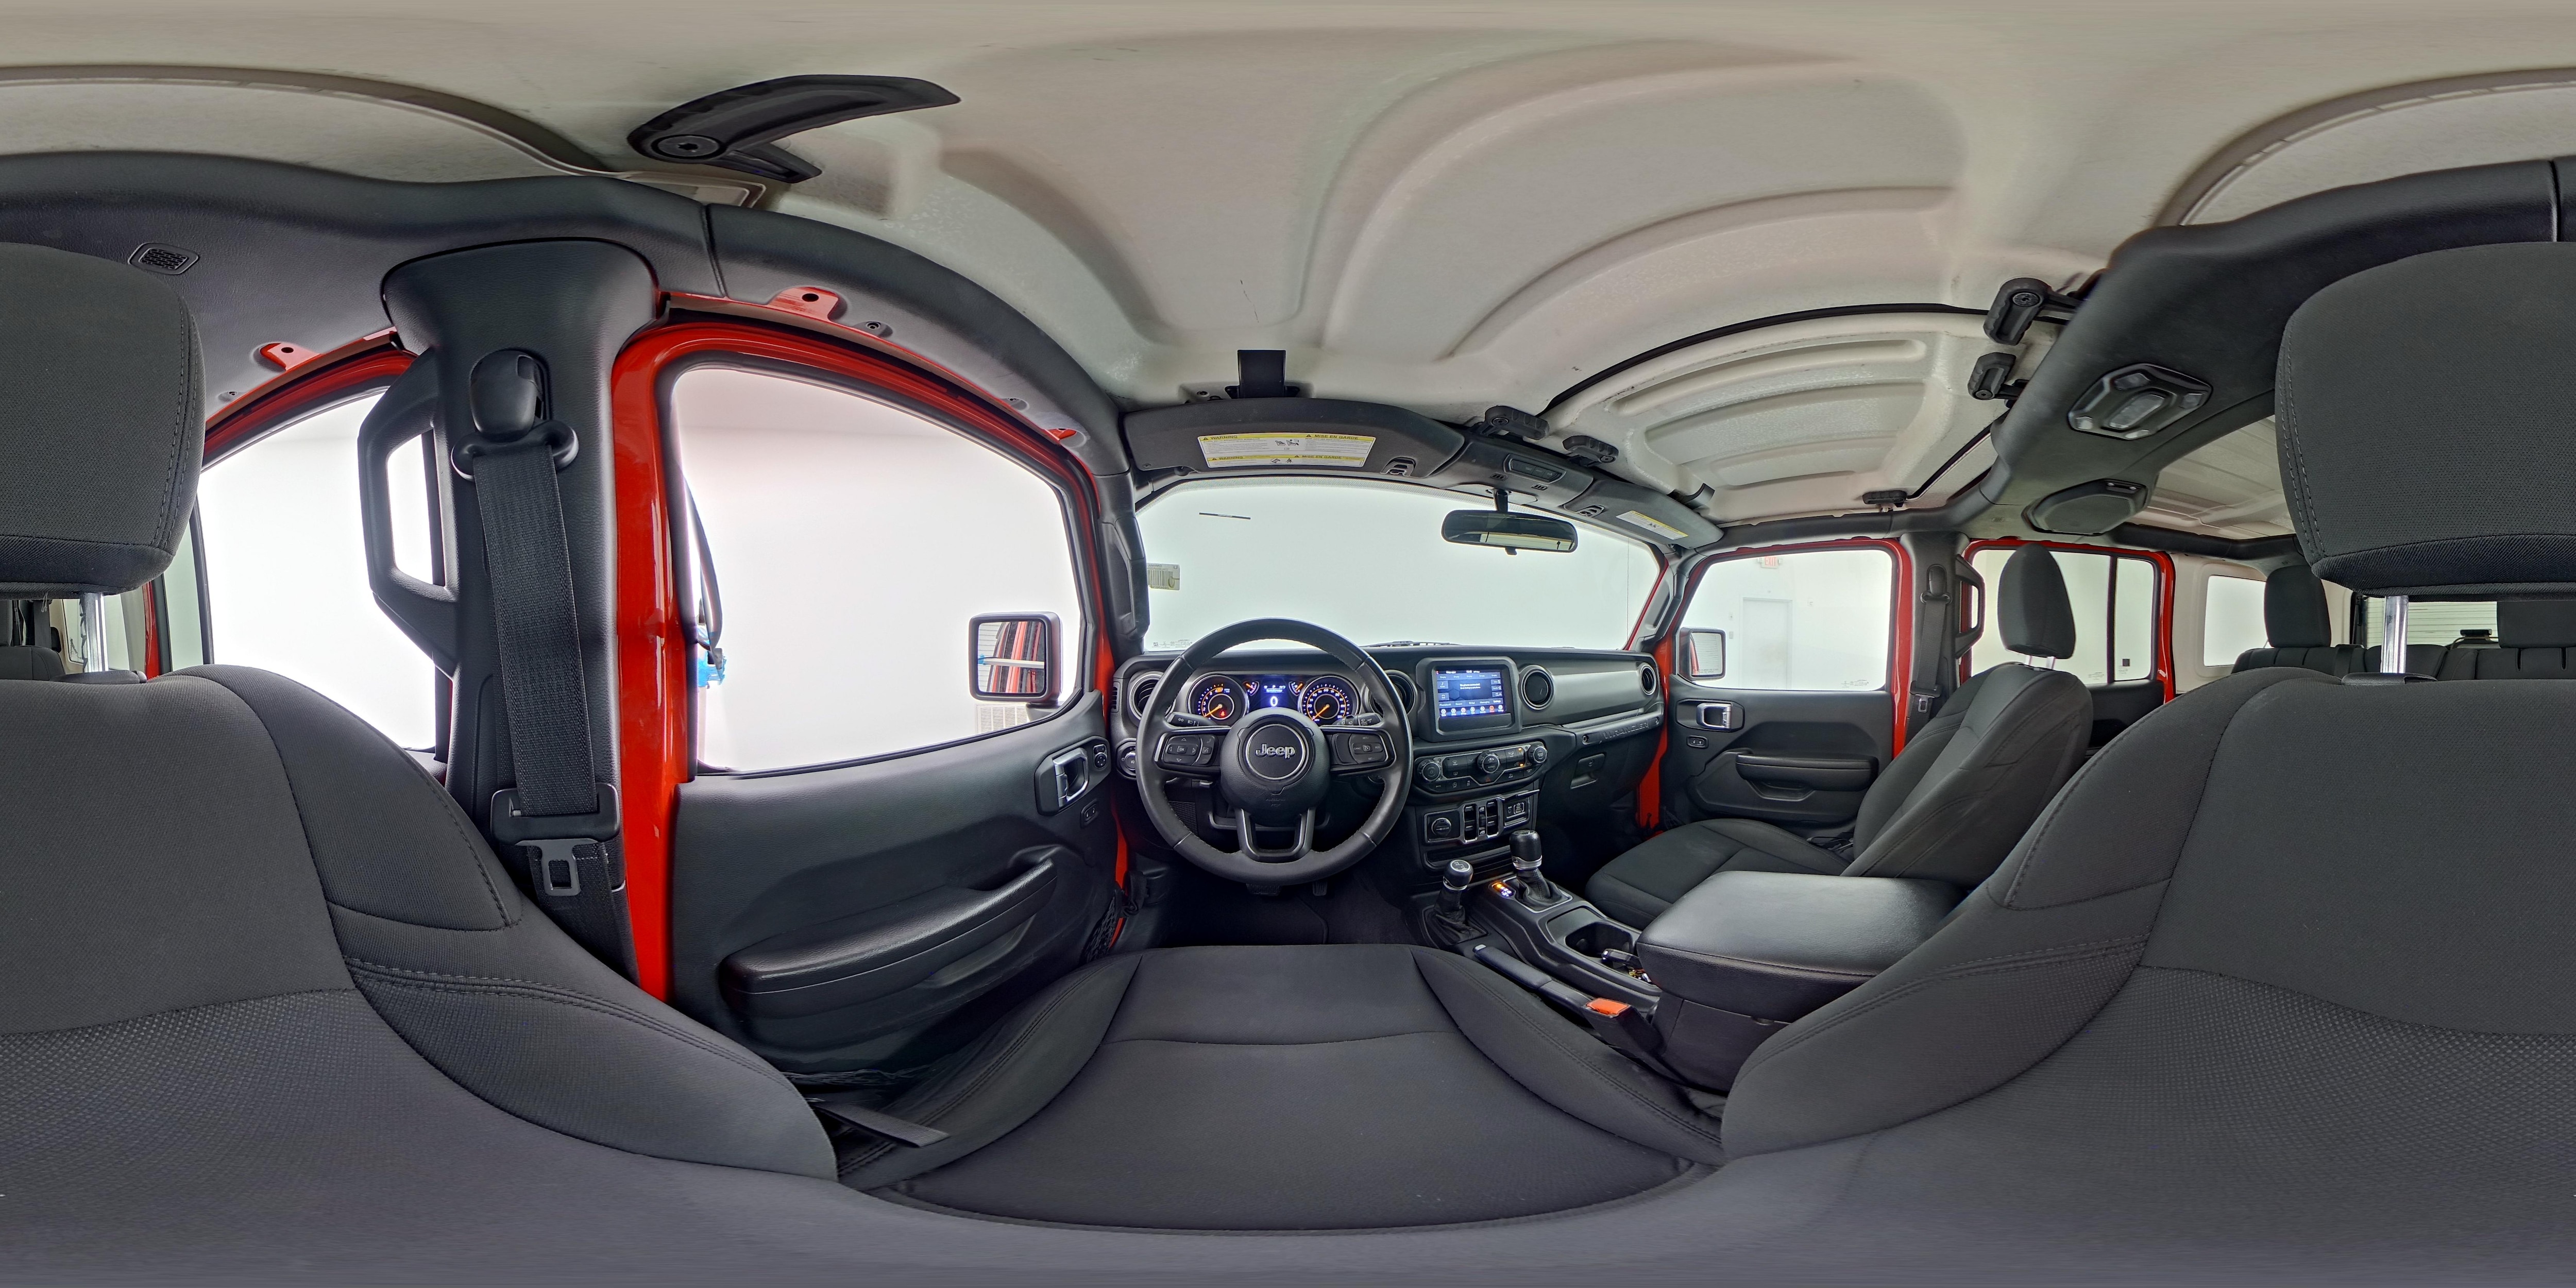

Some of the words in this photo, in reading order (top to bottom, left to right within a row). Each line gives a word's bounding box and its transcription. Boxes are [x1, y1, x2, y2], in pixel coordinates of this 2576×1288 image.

[1765, 556, 1777, 566] EXIT
[1270, 696, 1278, 707] 0
[1256, 743, 1296, 759] Jeep
